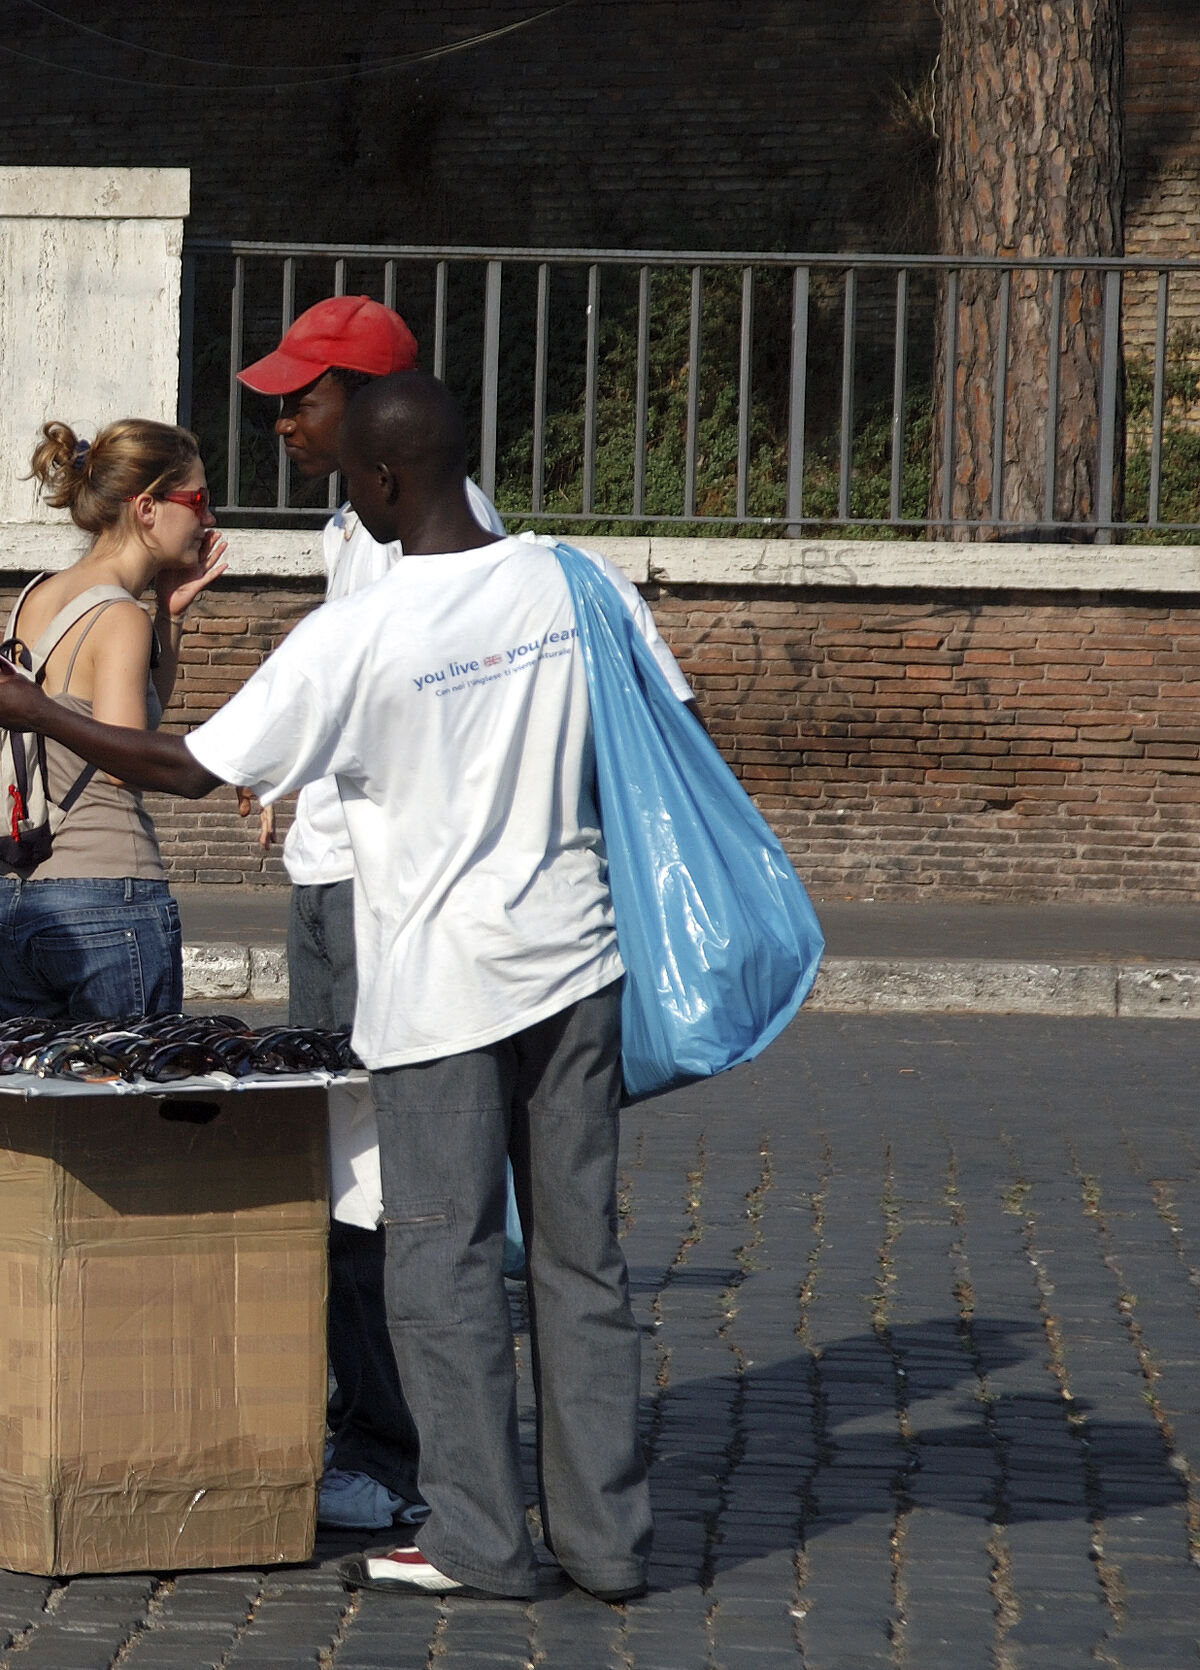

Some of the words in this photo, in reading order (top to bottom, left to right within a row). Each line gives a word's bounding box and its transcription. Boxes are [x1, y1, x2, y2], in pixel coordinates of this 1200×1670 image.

[413, 664, 445, 691] you
[449, 661, 480, 677] live
[506, 640, 540, 664] you
